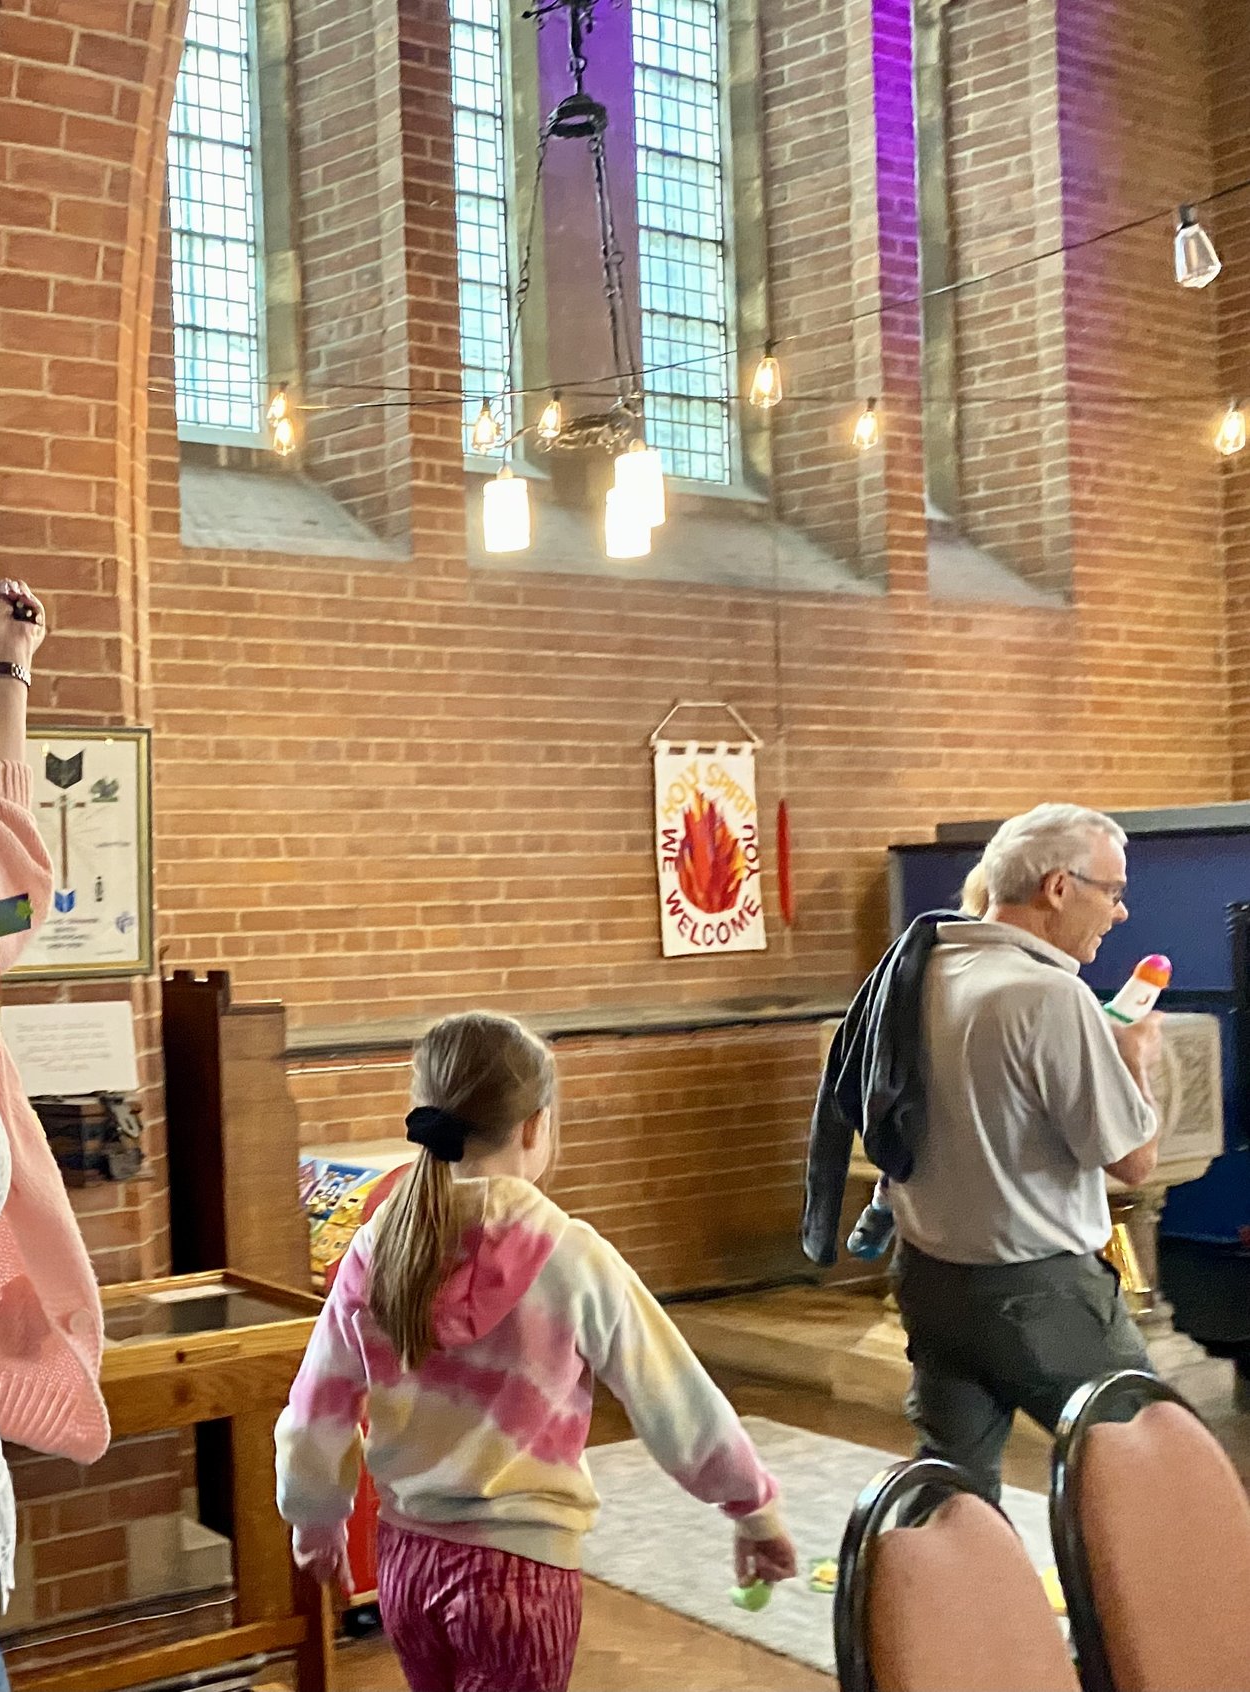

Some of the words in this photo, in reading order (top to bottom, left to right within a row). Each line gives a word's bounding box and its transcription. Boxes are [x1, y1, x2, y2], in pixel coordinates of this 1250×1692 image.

[662, 760, 700, 821] HOLY
[705, 762, 757, 818] SPIRIT
[661, 828, 678, 873] WE
[742, 824, 761, 882] YOU
[665, 889, 761, 946] WELCOME
